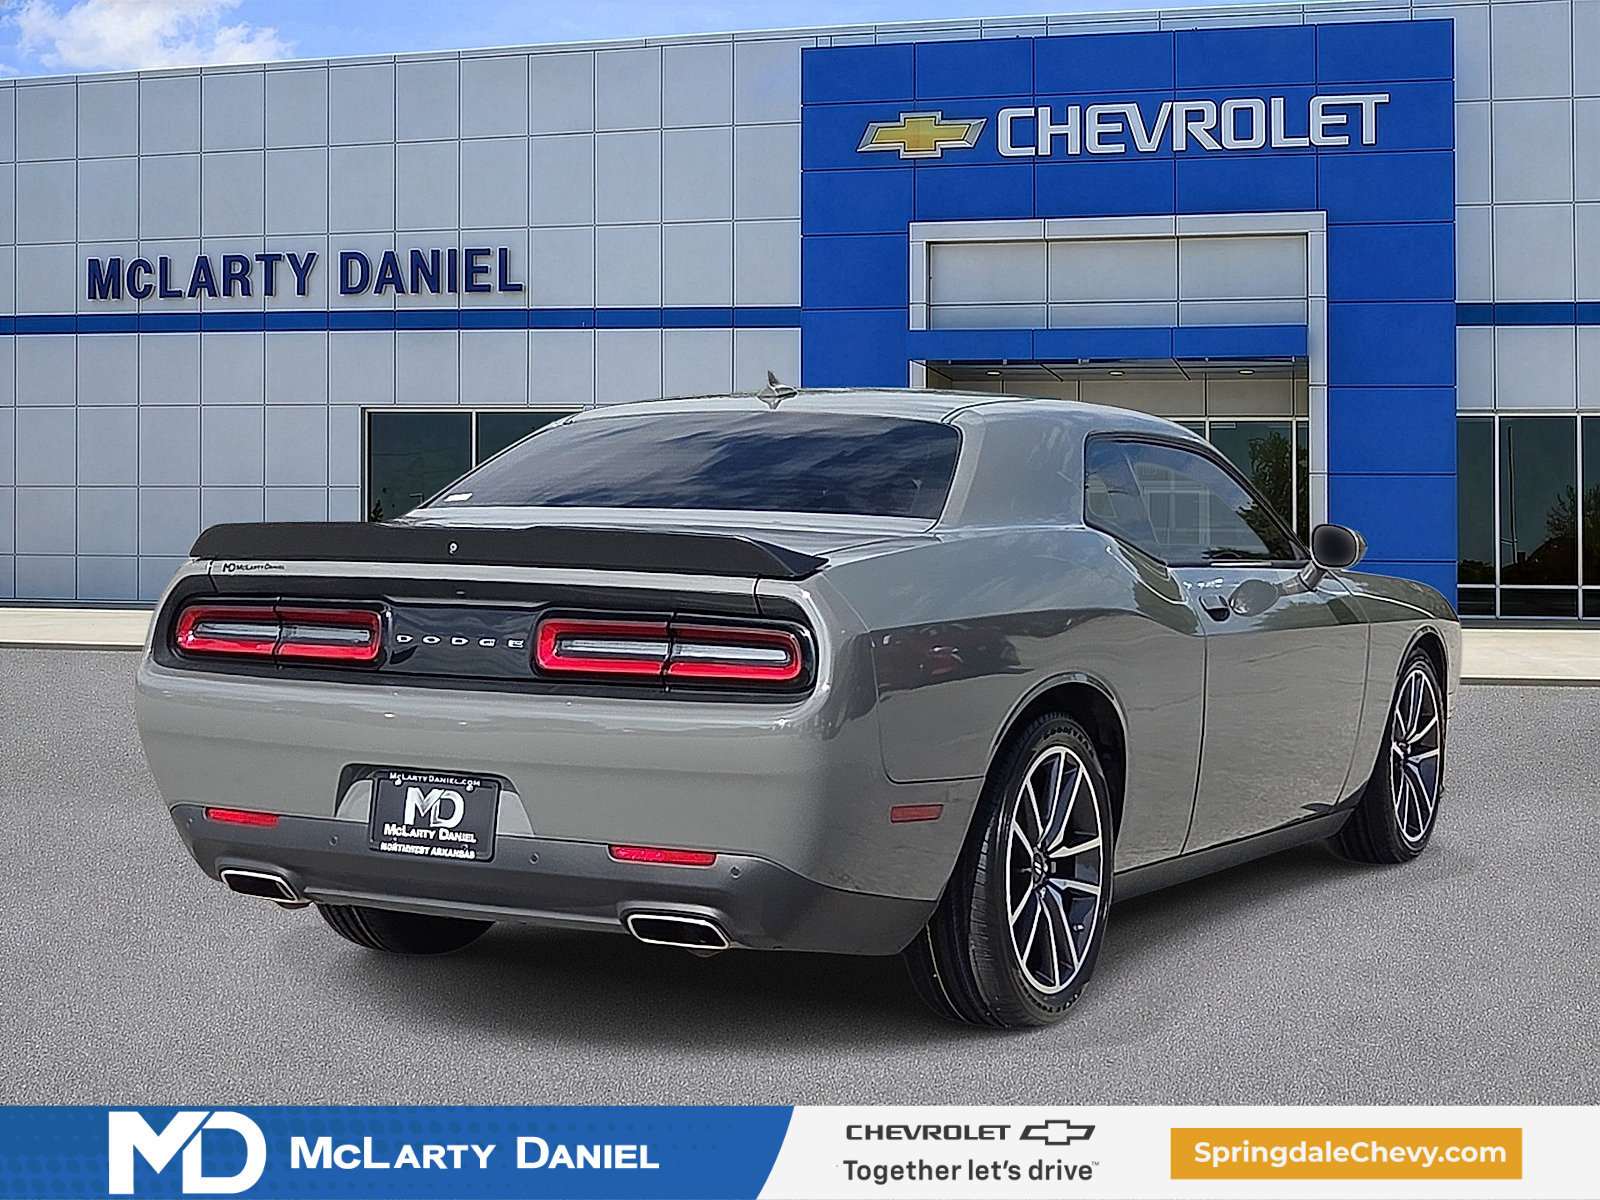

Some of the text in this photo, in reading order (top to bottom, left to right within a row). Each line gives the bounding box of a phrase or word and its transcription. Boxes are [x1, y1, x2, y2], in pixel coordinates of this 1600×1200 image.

[996, 93, 1390, 157] CHEVROLET
[338, 246, 524, 296] DANIEL
[396, 634, 524, 649] DODGE
[404, 786, 465, 829] MD
[438, 827, 477, 844] DANIEL
[430, 846, 476, 860] ARKANSAS
